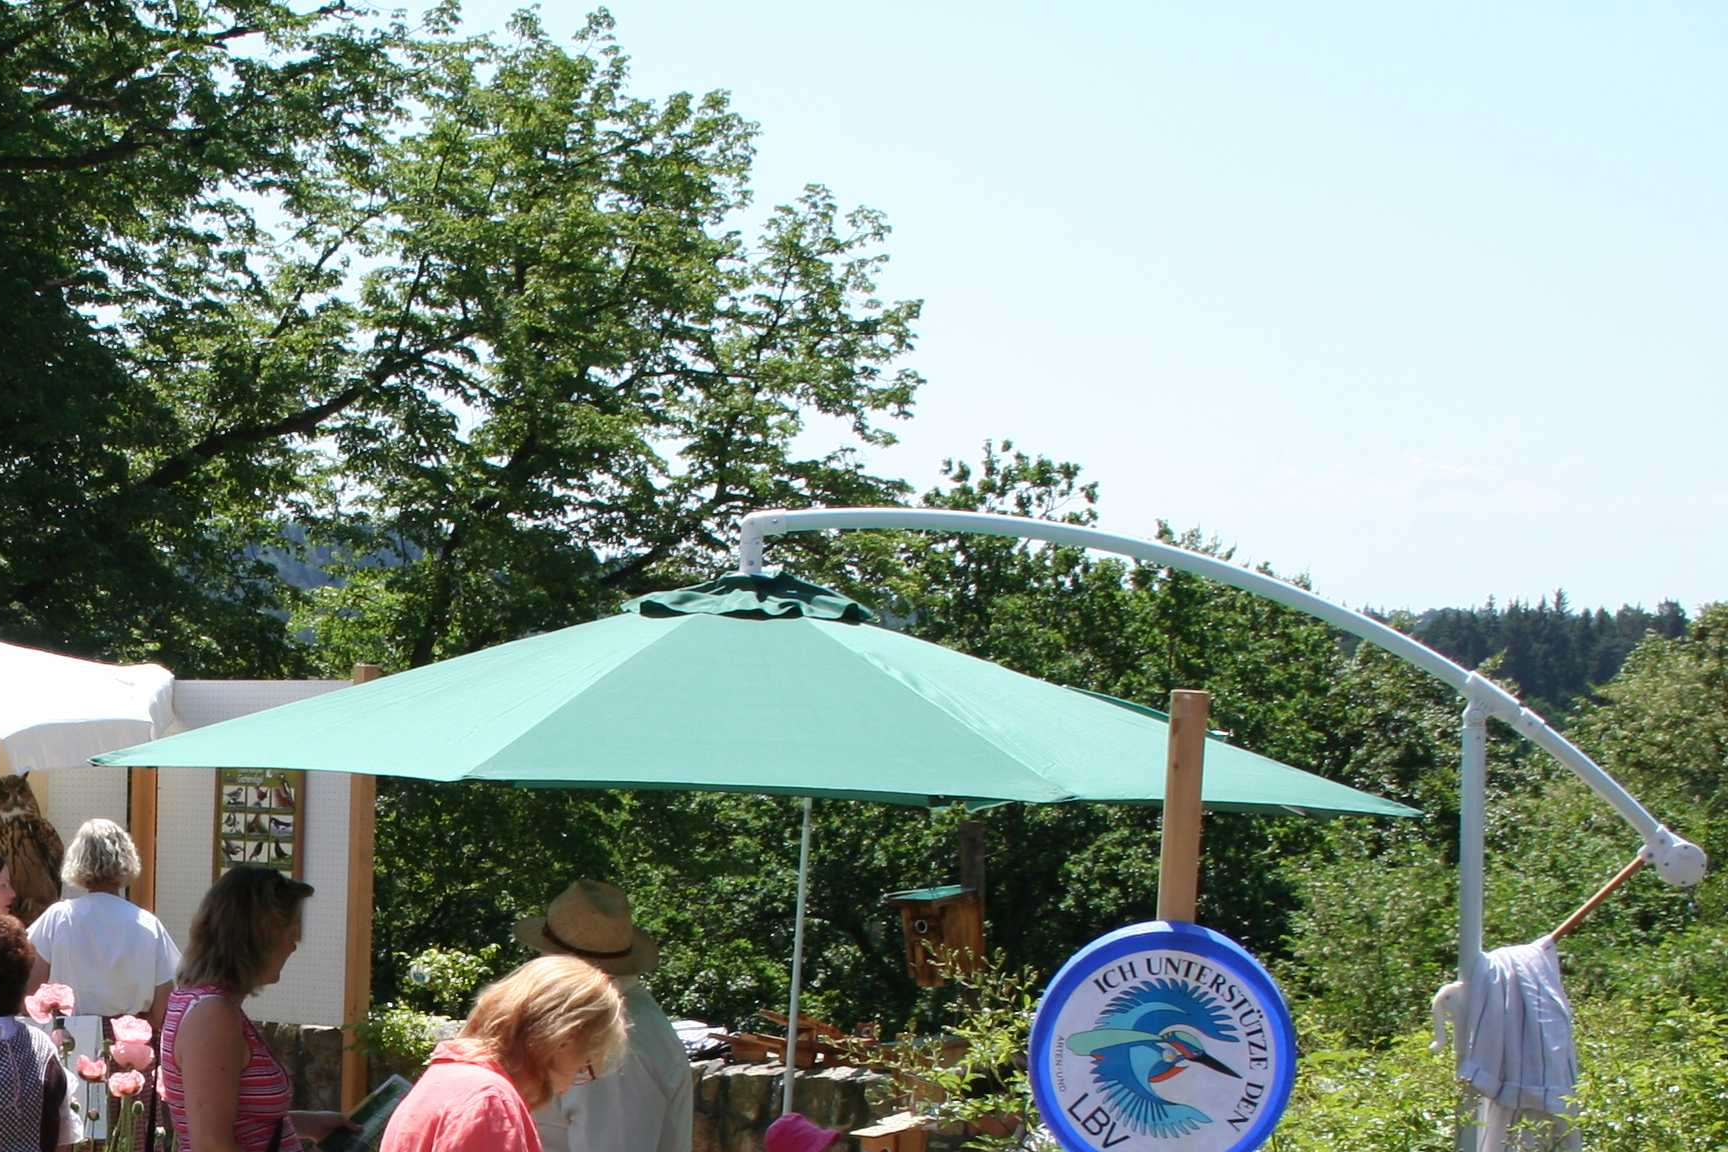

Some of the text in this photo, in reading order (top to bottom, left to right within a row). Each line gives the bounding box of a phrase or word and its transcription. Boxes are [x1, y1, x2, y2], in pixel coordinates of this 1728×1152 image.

[1093, 957, 1269, 1132] ICH UNTERSTÜTZE DEN
[1067, 1092, 1131, 1149] LBV
